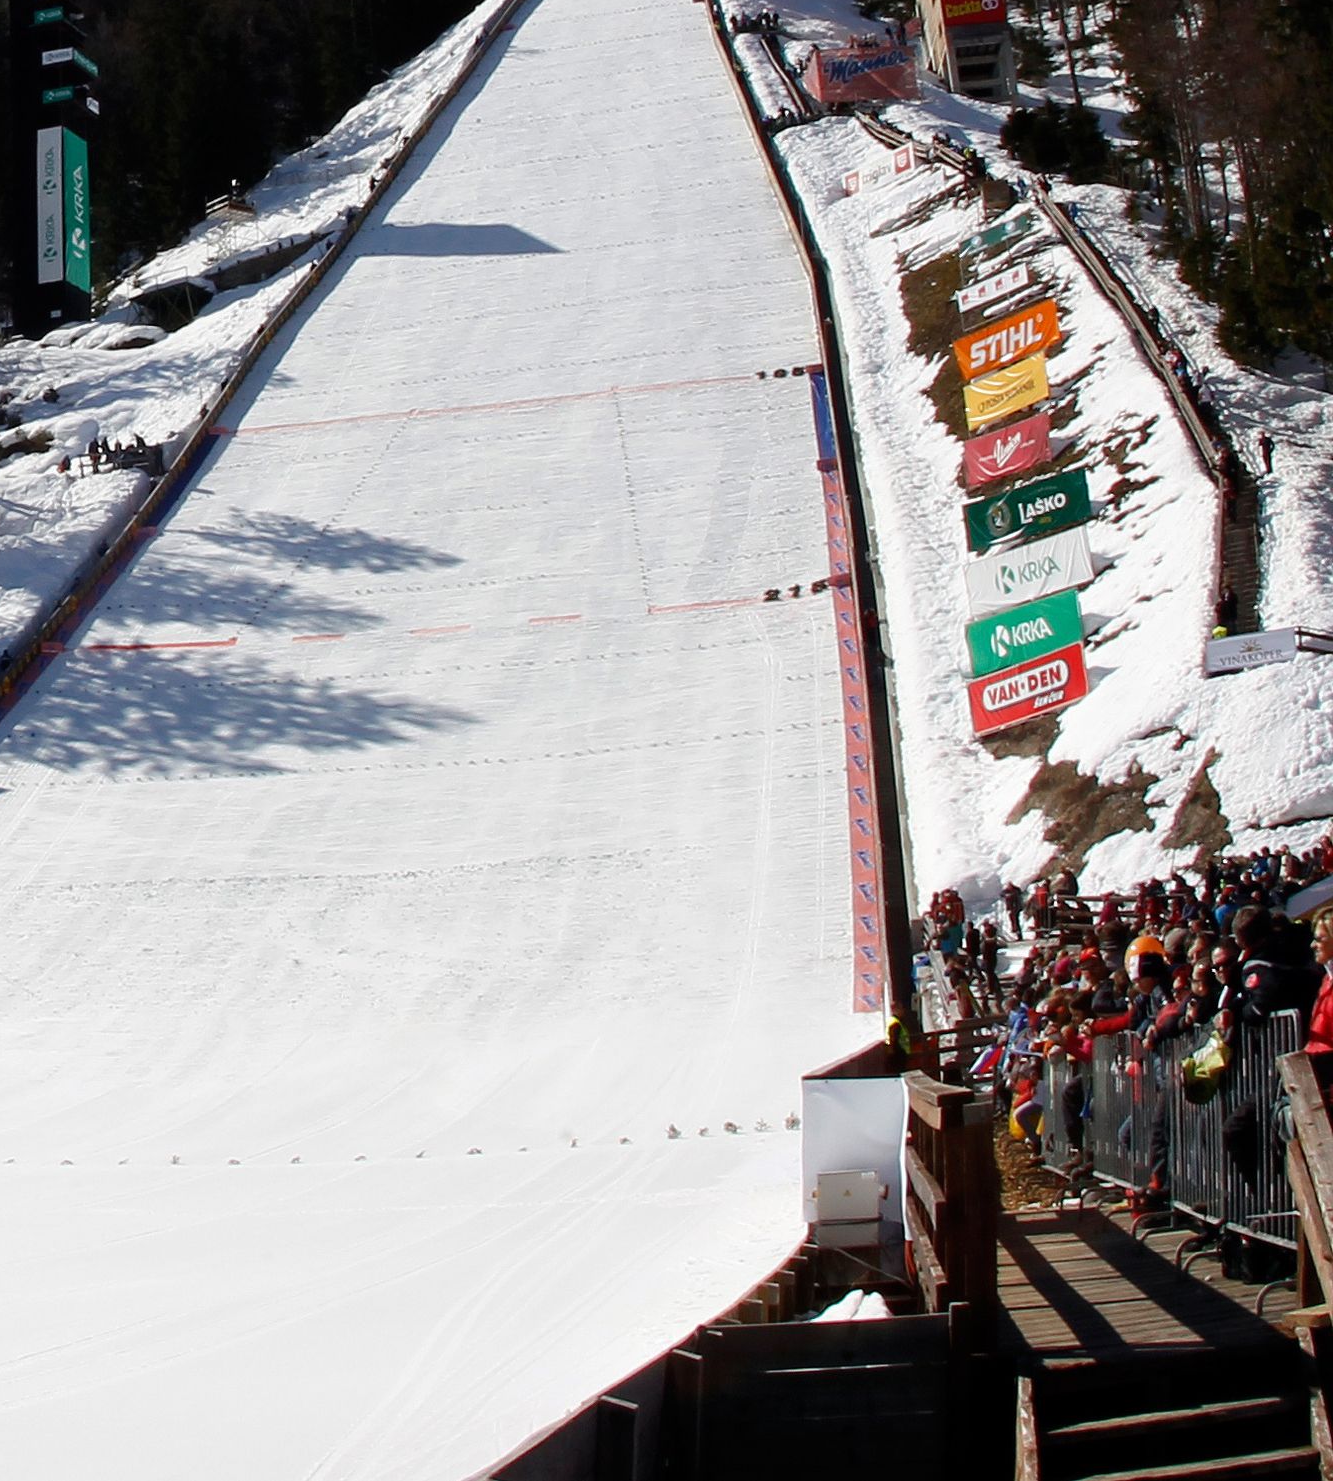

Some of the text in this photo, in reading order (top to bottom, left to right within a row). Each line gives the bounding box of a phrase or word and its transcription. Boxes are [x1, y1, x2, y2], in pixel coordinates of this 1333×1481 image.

[73, 165, 83, 224] KRKA
[969, 319, 1041, 370] STIHL
[1018, 492, 1066, 524] LAŠKO
[1018, 556, 1061, 584] KRKA
[1010, 617, 1053, 647] KRKA
